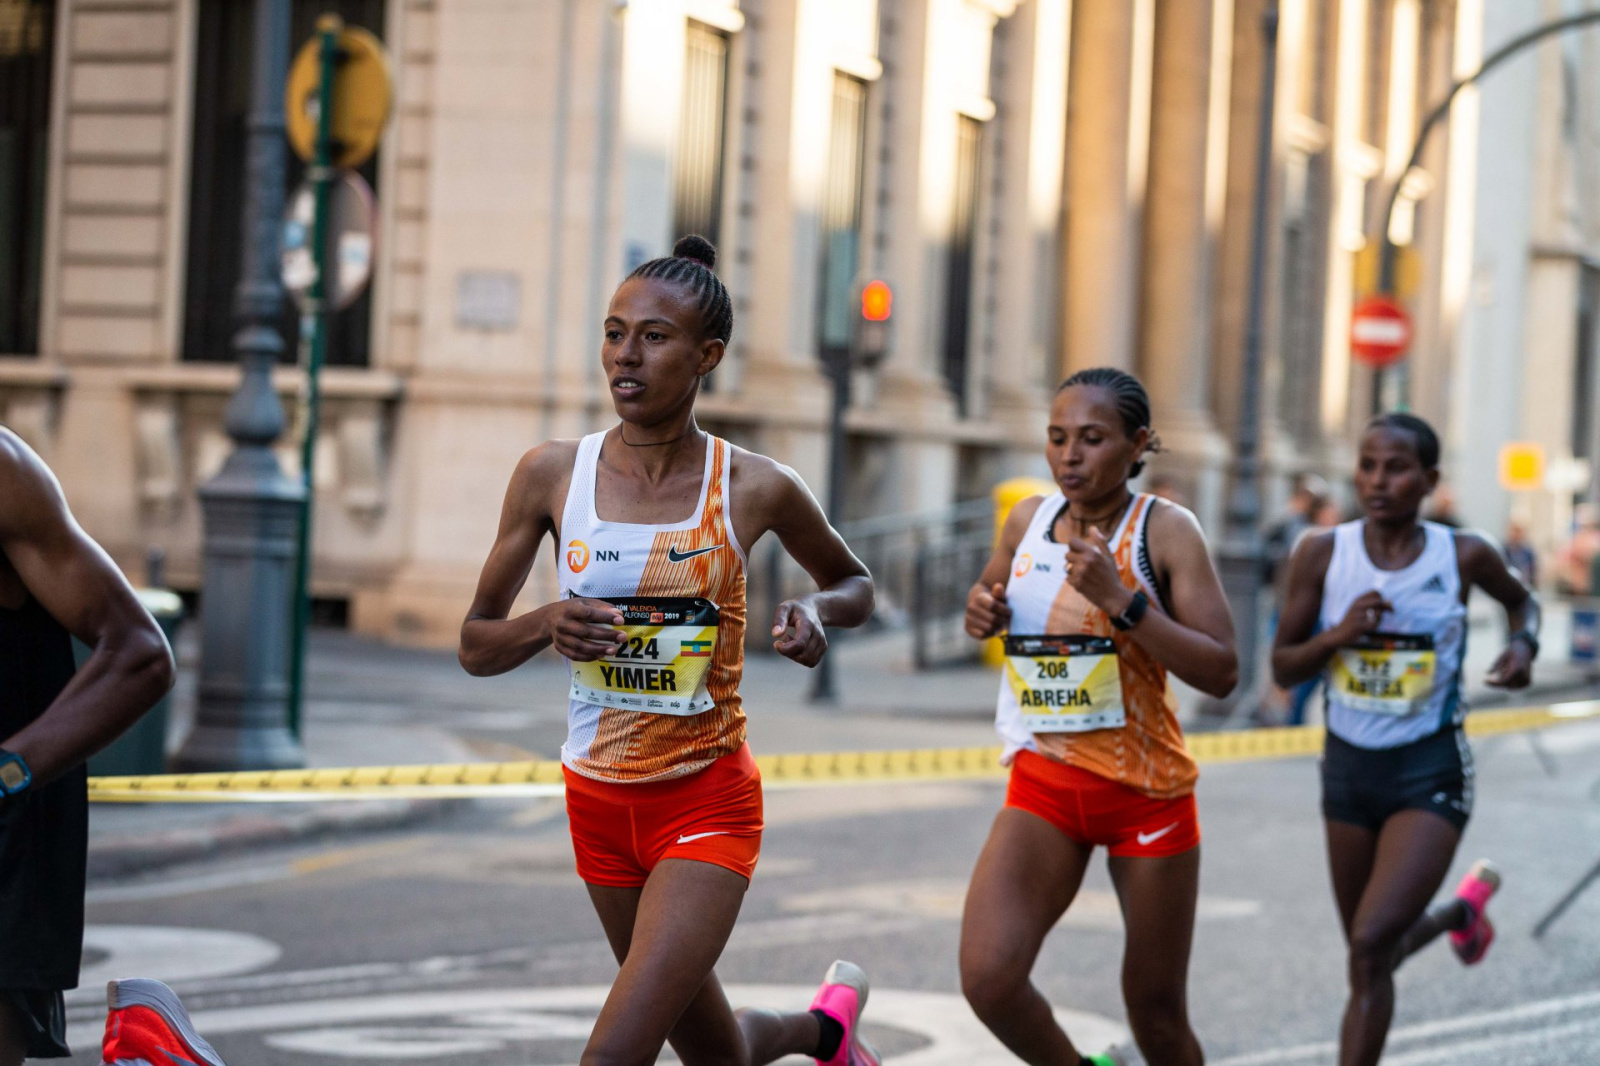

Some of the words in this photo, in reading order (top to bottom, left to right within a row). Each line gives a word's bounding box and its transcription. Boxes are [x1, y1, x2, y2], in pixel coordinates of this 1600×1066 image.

[595, 550, 620, 562] NN
[624, 611, 650, 619] ALFONSO
[614, 636, 660, 660] 224
[600, 665, 677, 692] YIMER
[1036, 661, 1069, 679] 208
[1021, 689, 1092, 707] ABREHA
